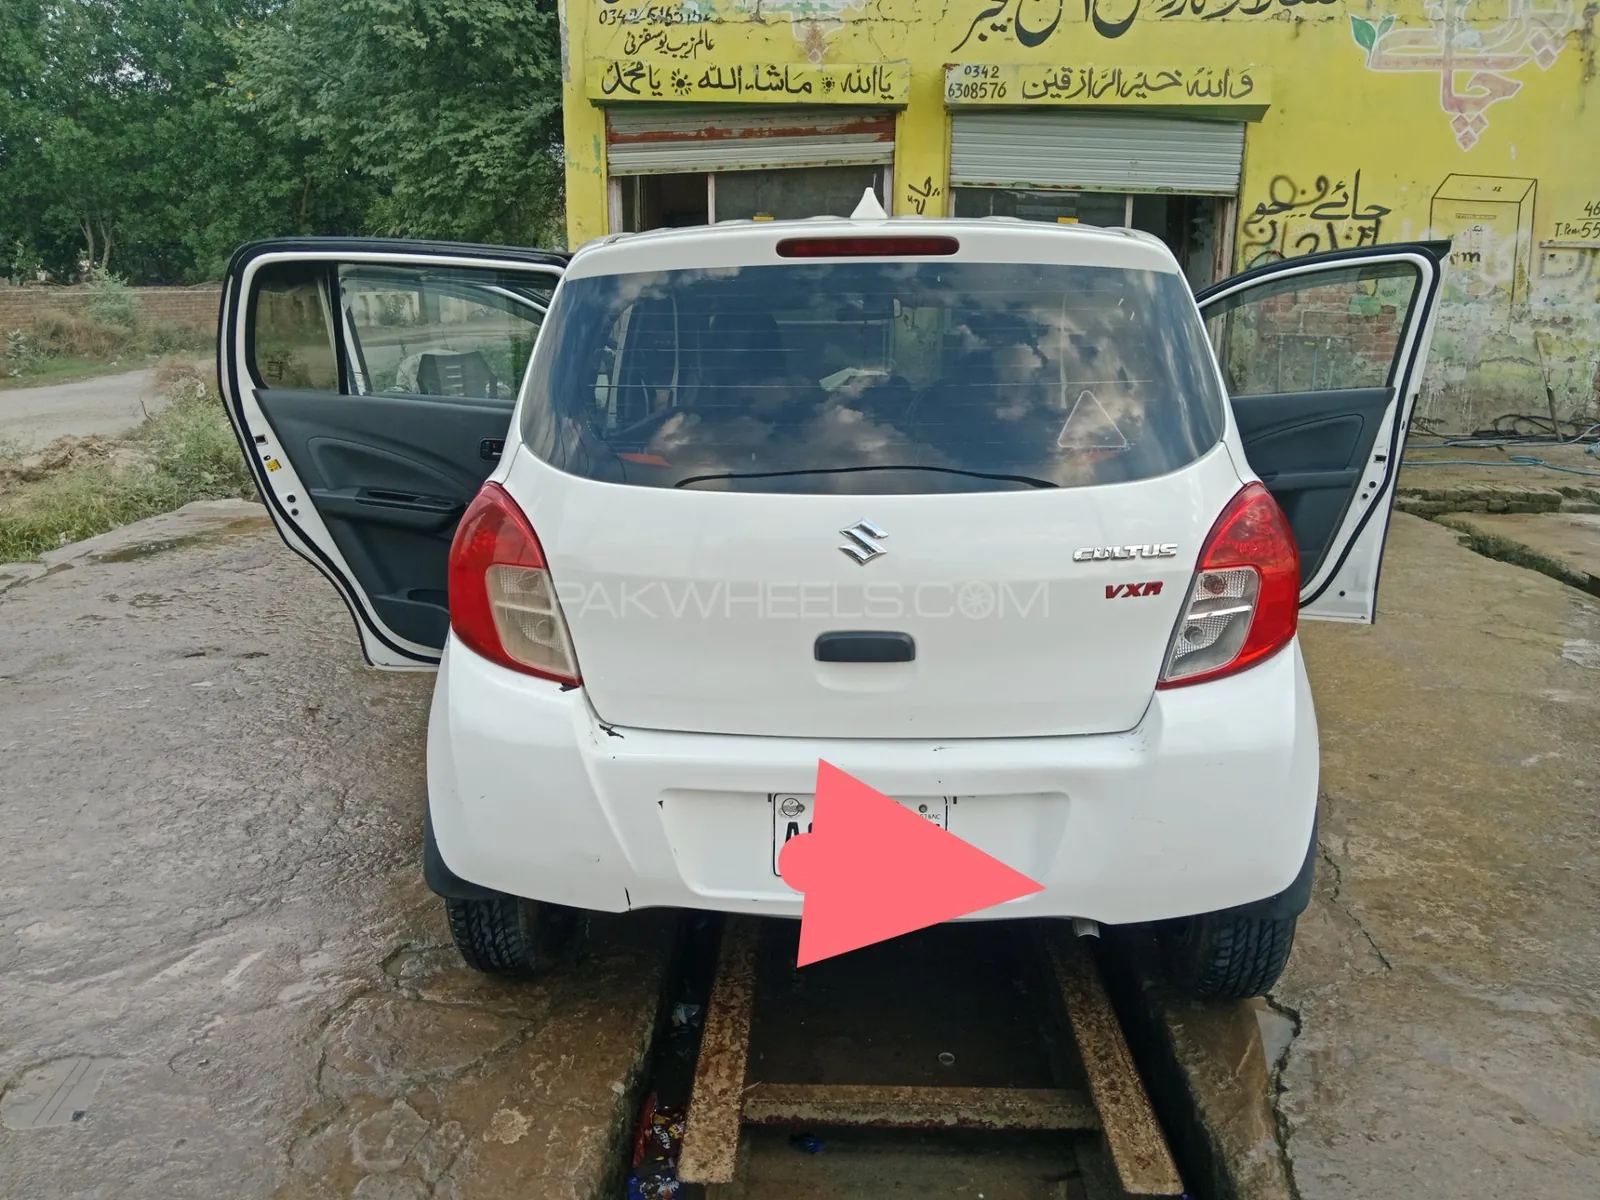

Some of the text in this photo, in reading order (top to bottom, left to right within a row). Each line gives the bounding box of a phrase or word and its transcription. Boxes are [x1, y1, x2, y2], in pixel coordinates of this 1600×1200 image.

[964, 65, 1000, 79] 0342
[947, 81, 1007, 99] 6308576
[1073, 543, 1178, 562] CULTUS
[1105, 581, 1163, 599] VXR
